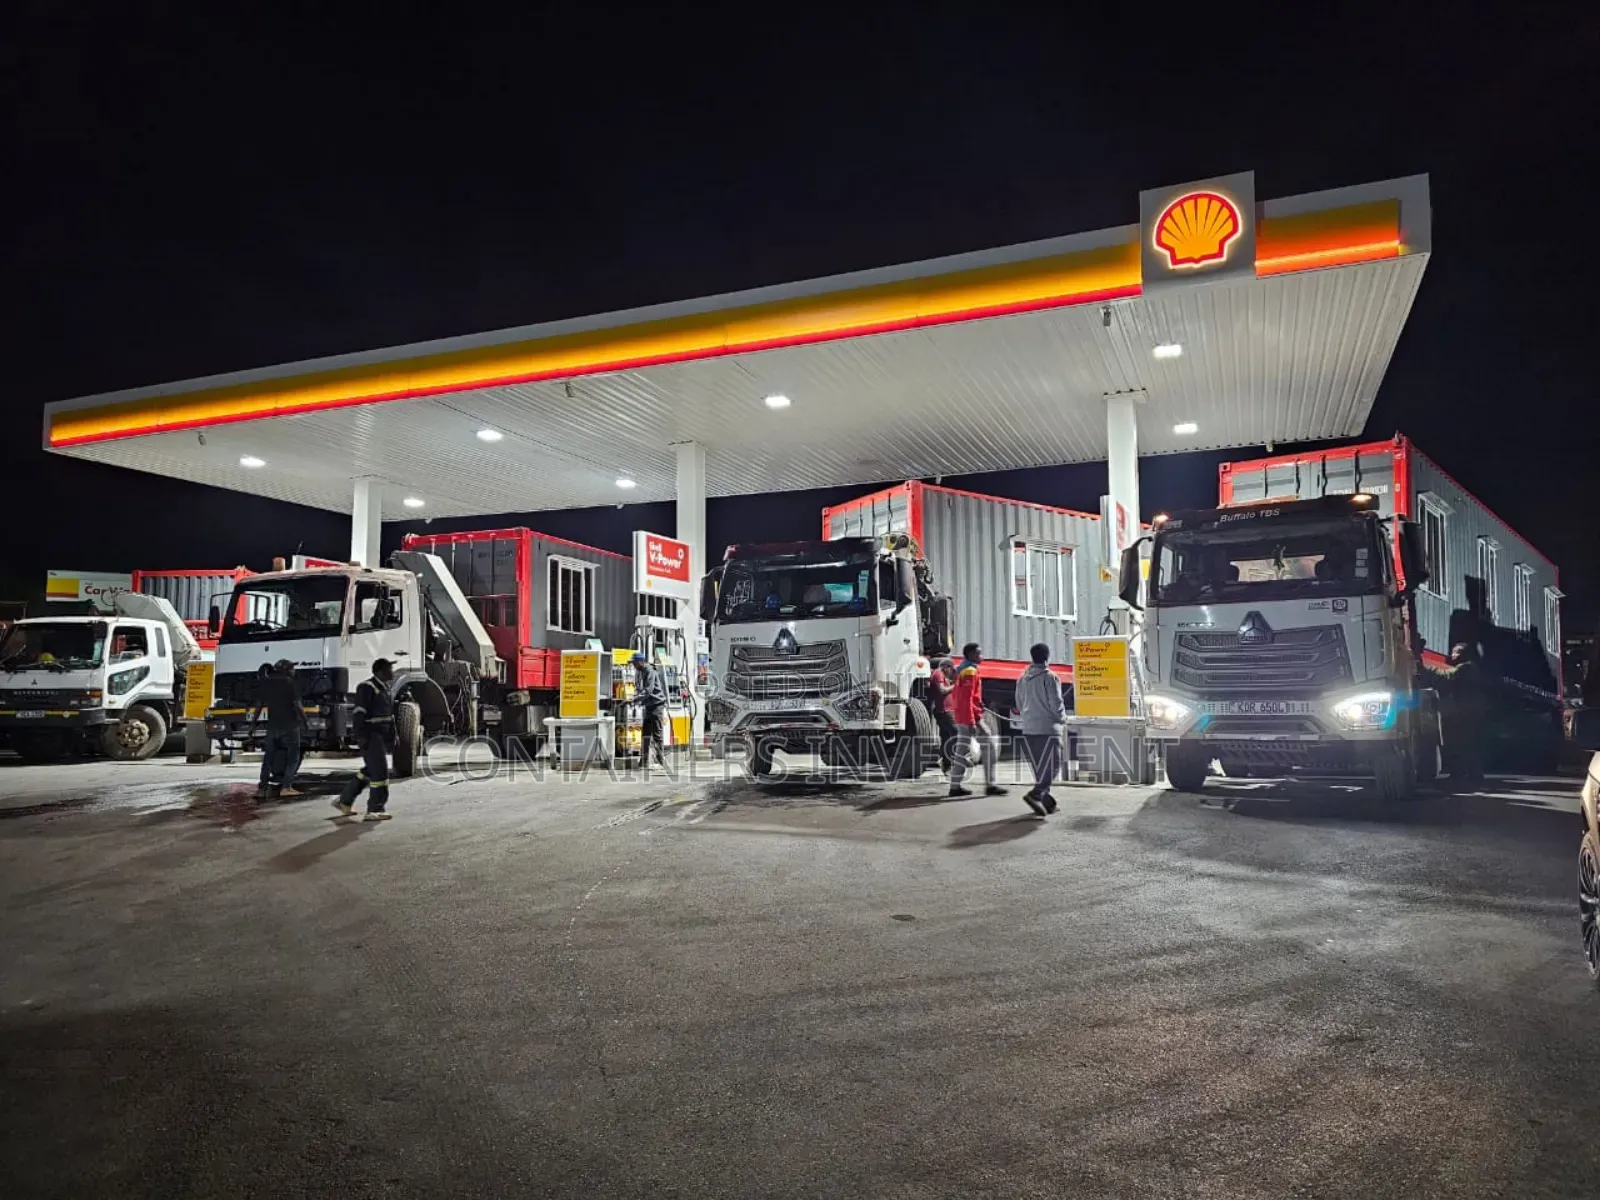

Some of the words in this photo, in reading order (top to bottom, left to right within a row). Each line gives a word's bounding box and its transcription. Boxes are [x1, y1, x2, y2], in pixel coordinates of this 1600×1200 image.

[1220, 511, 1256, 523] Buffalo
[650, 550, 682, 570] V-Power
[84, 586, 107, 595] Car
